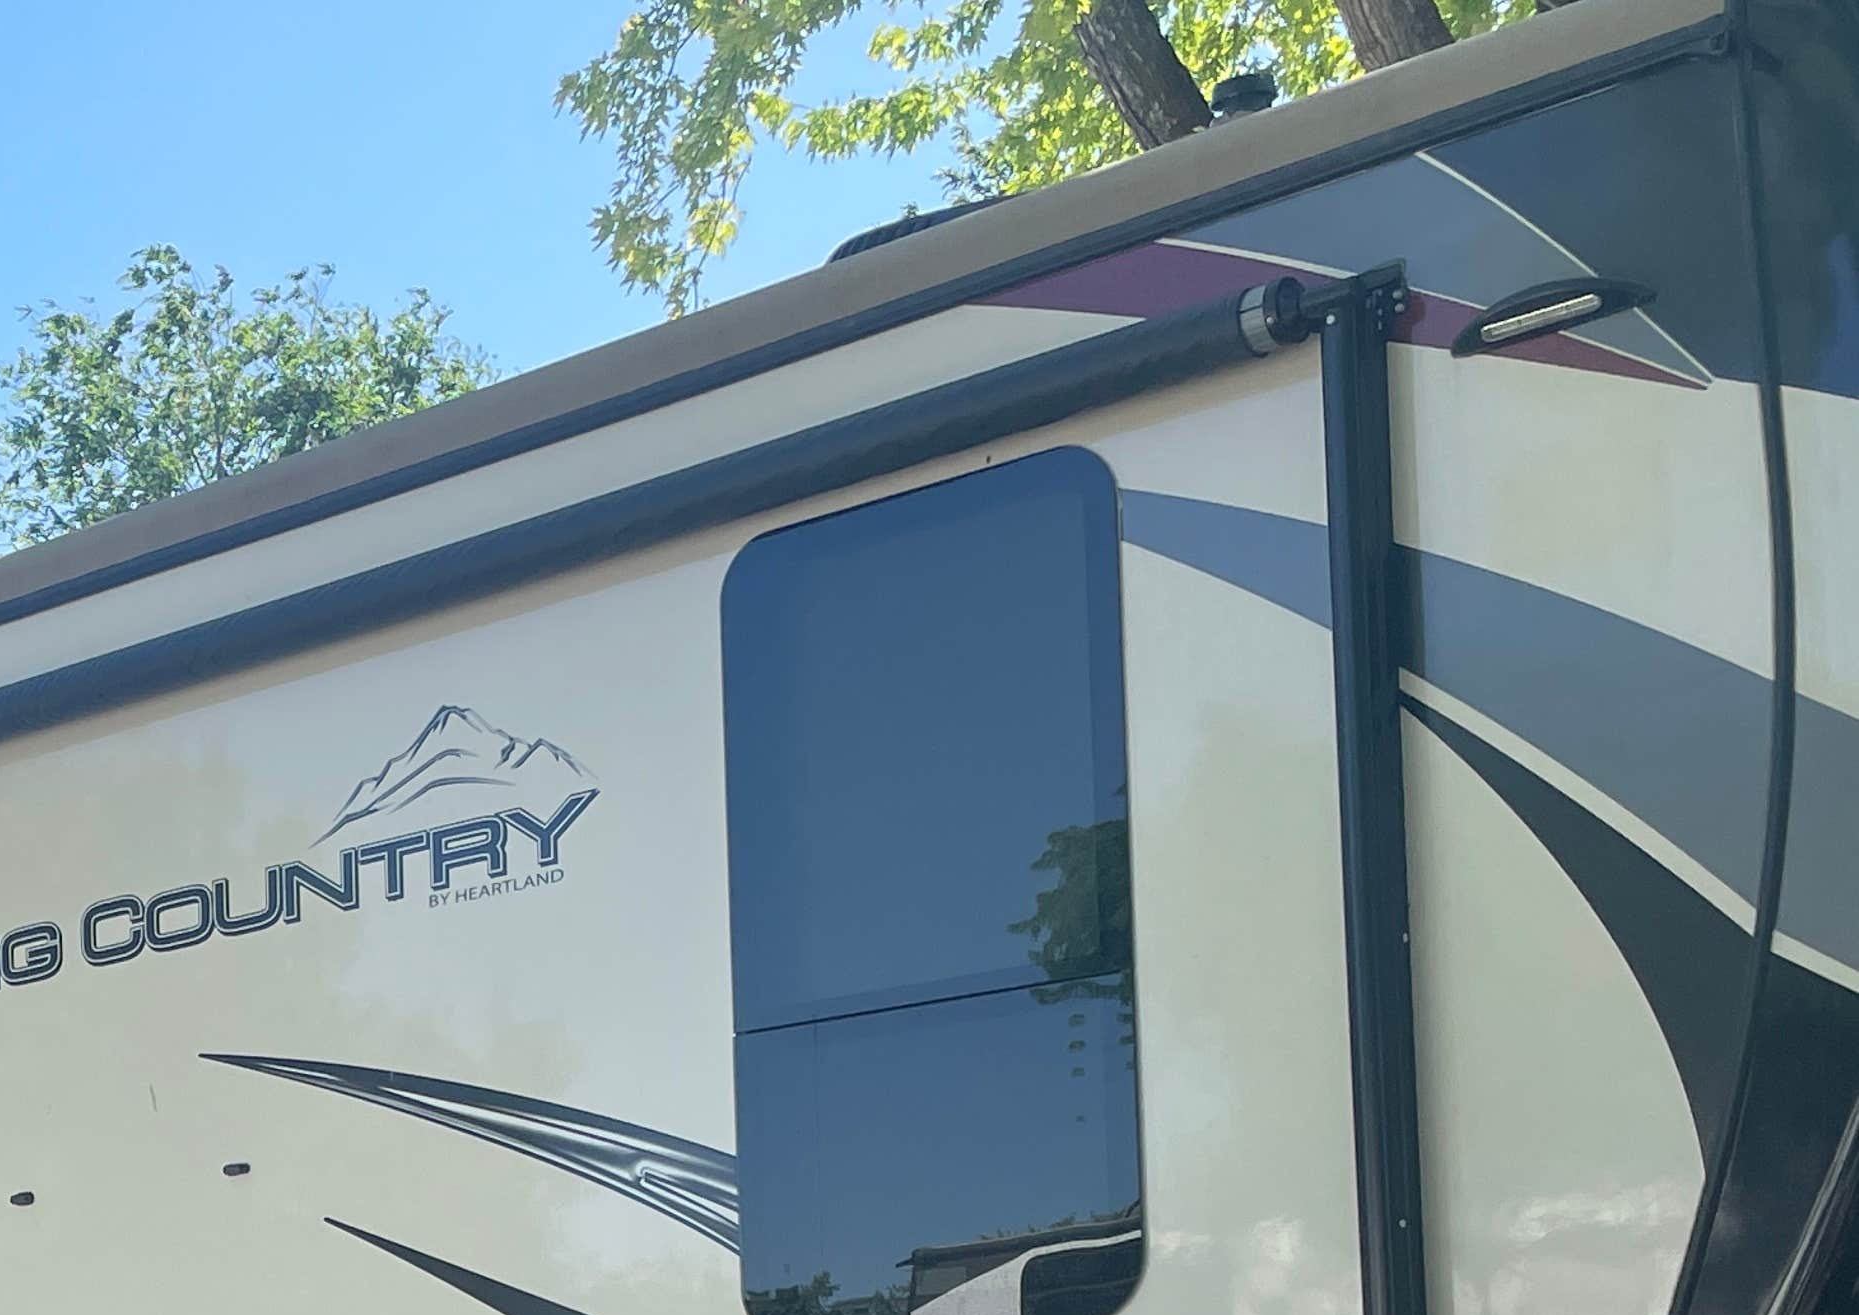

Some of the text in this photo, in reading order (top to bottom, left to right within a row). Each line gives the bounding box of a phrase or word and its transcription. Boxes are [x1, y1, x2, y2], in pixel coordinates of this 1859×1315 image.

[81, 788, 600, 967] COUNTRY
[428, 869, 565, 909] BY HEARTLAND
